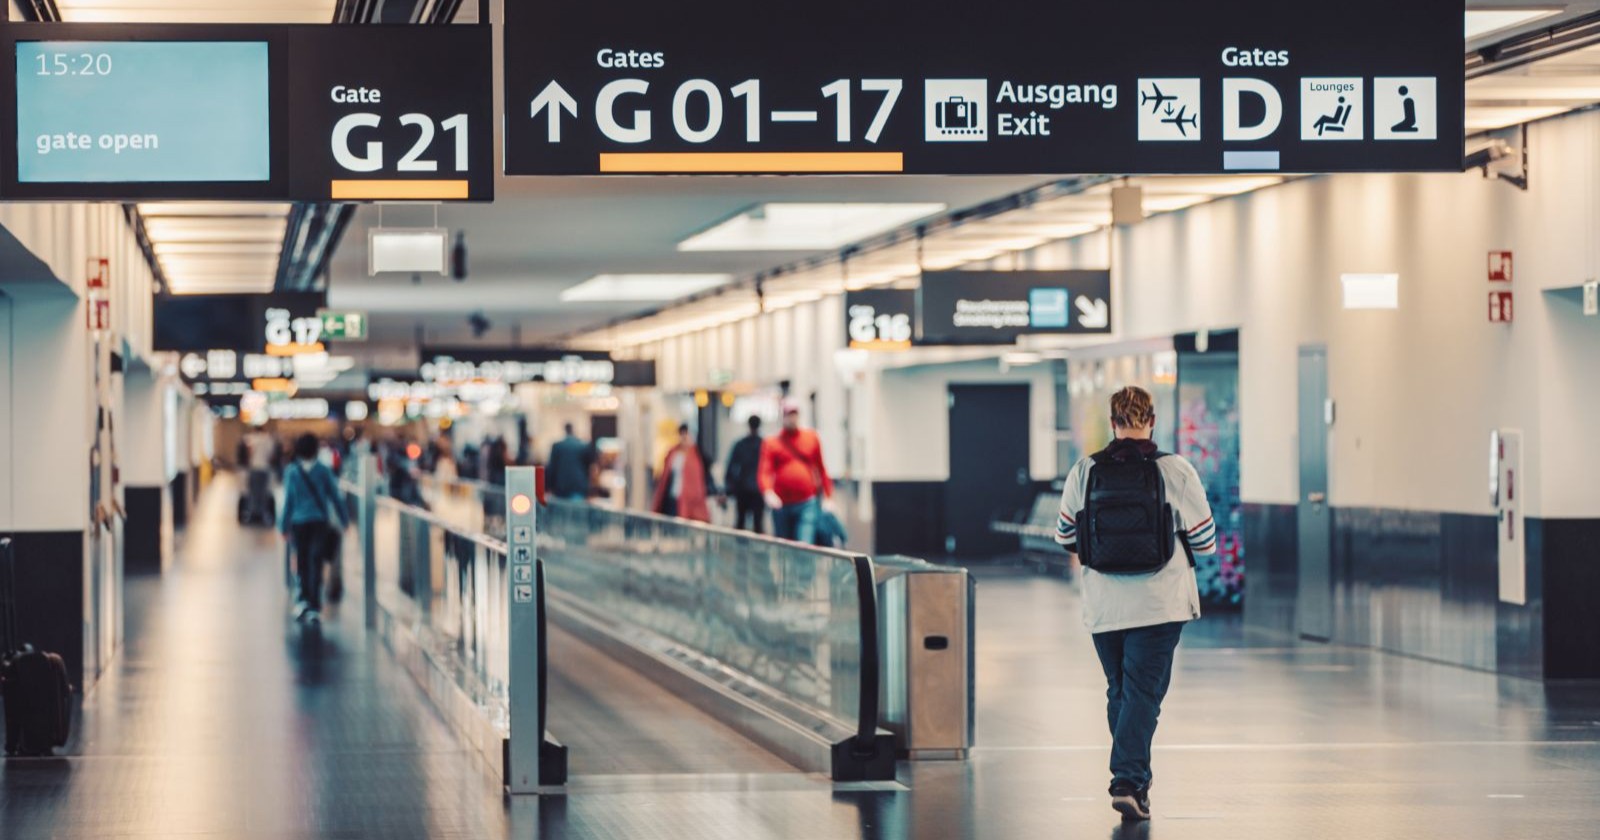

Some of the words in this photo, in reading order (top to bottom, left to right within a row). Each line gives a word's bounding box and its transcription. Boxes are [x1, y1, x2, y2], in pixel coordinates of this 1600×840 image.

[36, 53, 112, 76] 15:20
[596, 48, 665, 68] Gates
[1221, 47, 1290, 67] Gates
[330, 85, 381, 104] Gate
[996, 81, 1118, 109] Ausgang
[1310, 82, 1355, 94] Lounges
[595, 78, 652, 144] G
[1222, 78, 1283, 141] D
[997, 111, 1051, 136] Exit
[36, 131, 92, 155] gate
[98, 133, 159, 155] open
[330, 112, 384, 173] G
[396, 112, 469, 172] 21
